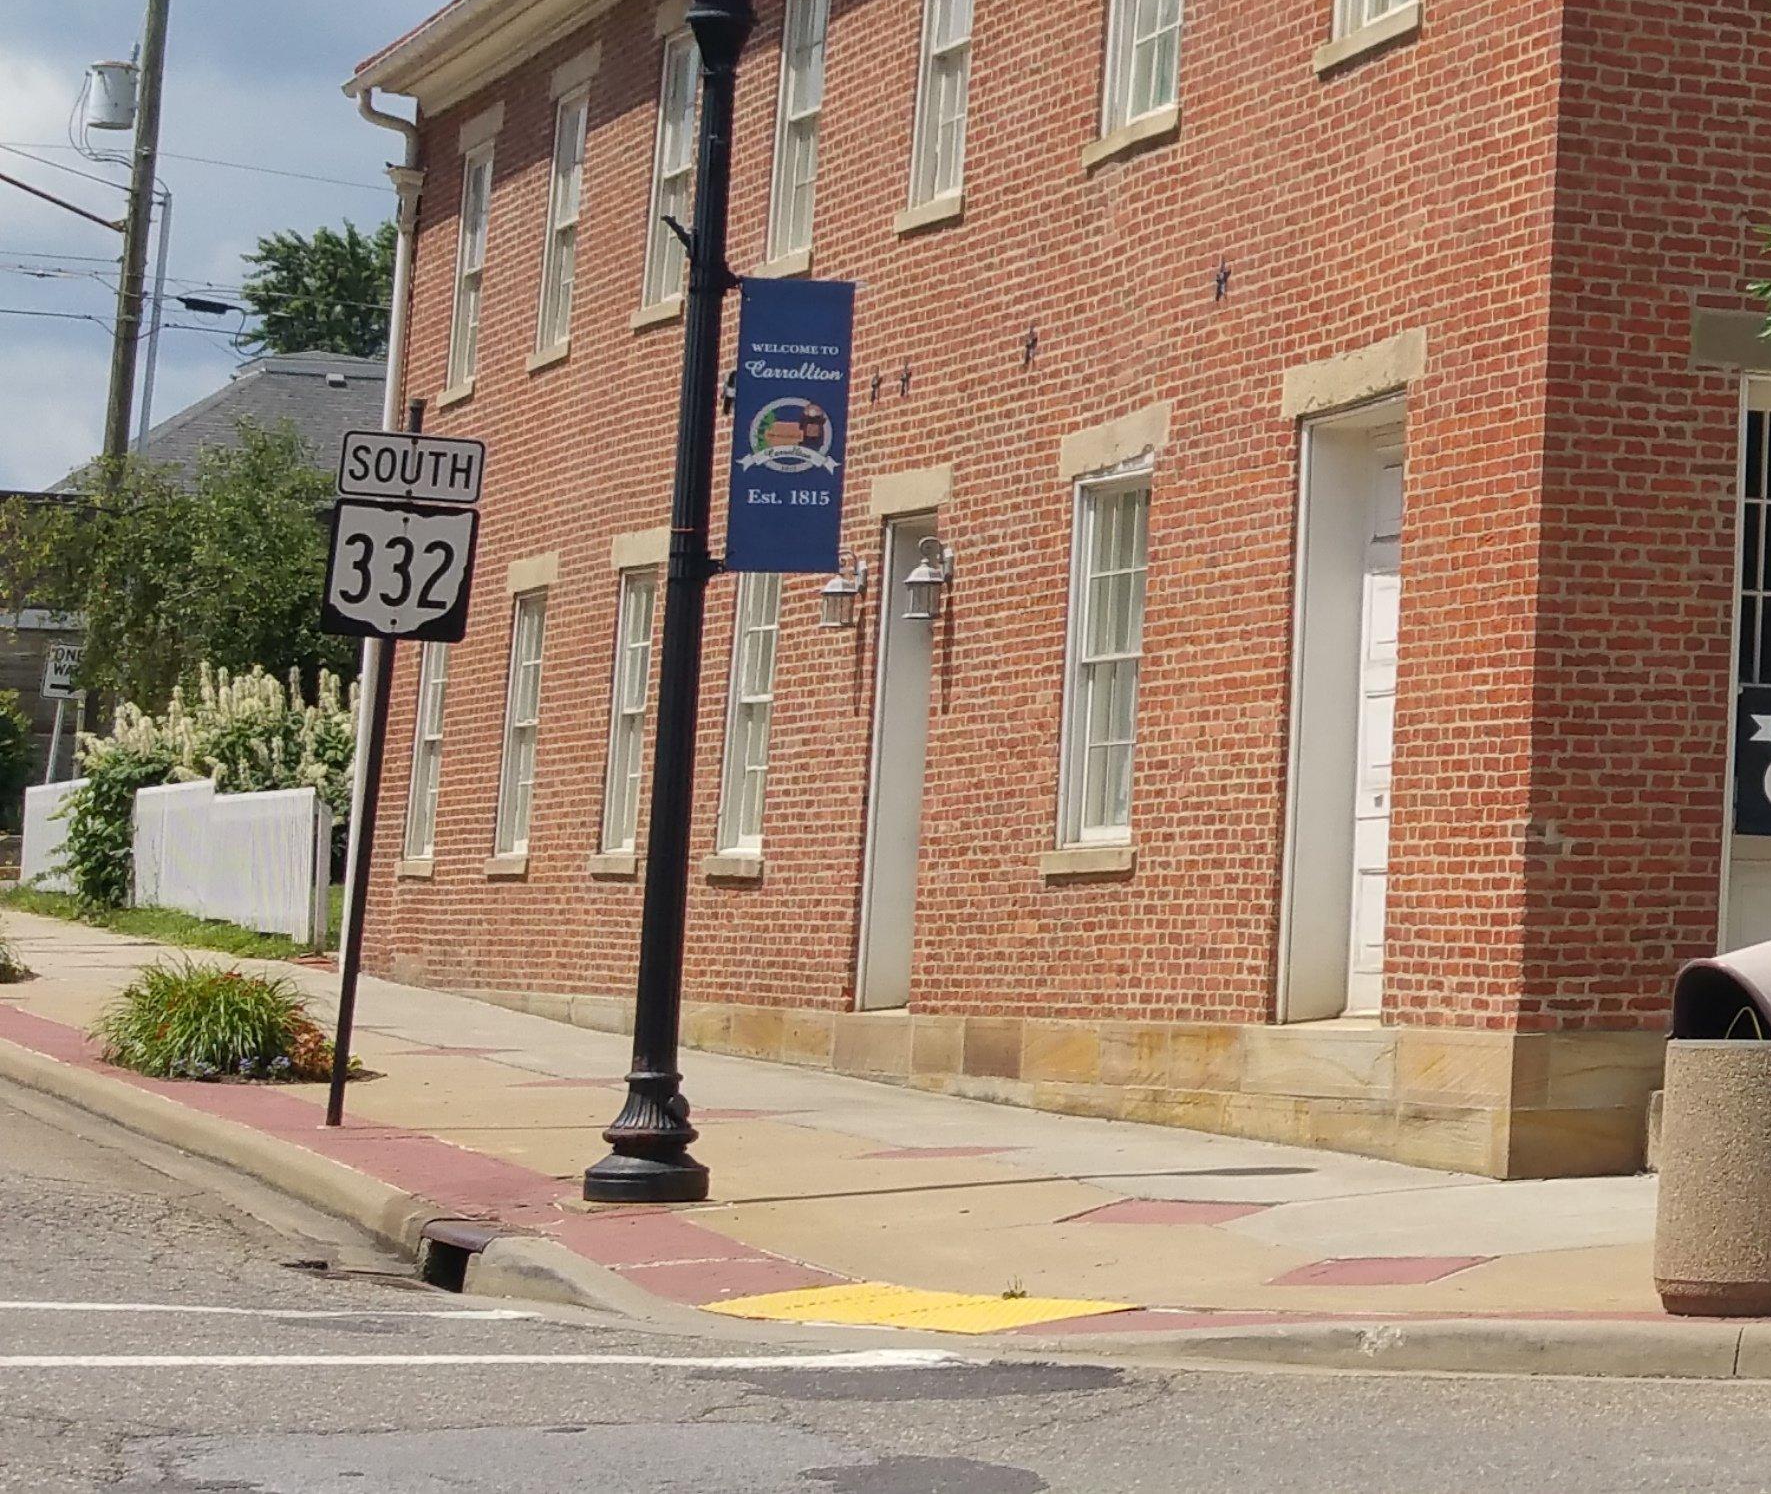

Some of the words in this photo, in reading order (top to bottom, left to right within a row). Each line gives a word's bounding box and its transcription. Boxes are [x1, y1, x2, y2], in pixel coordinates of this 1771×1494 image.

[752, 343, 818, 354] WELCOME
[820, 345, 839, 355] TO
[745, 360, 843, 380] Carrollton
[349, 445, 473, 489] SOUTH
[748, 488, 783, 504] Est.
[790, 489, 830, 505] 1815
[339, 533, 455, 610] 332
